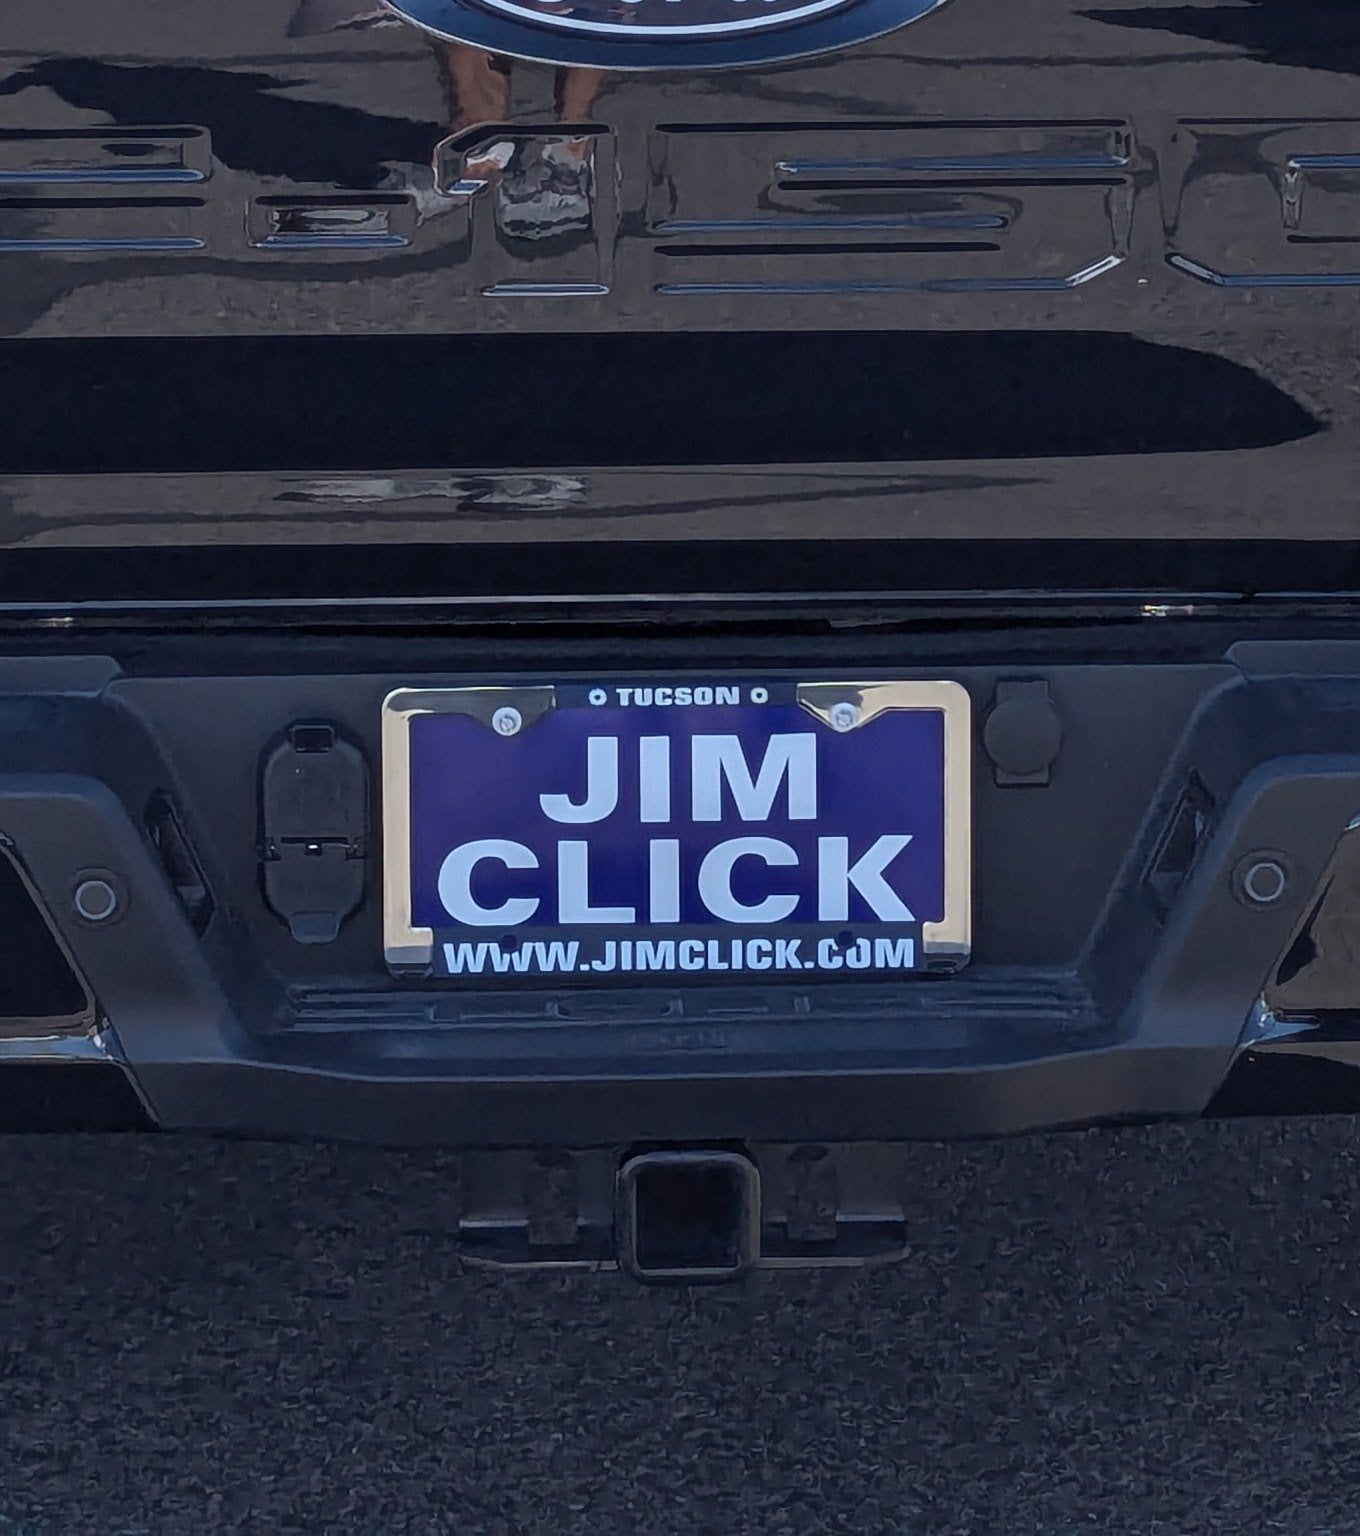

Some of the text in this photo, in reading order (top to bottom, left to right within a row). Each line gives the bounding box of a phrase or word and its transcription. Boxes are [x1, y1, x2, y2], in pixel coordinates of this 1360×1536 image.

[615, 686, 740, 707] TUCSON
[539, 732, 818, 825] JIM
[437, 834, 917, 927] CLICK
[442, 937, 915, 974] WWW.JIMCLICK.COM
